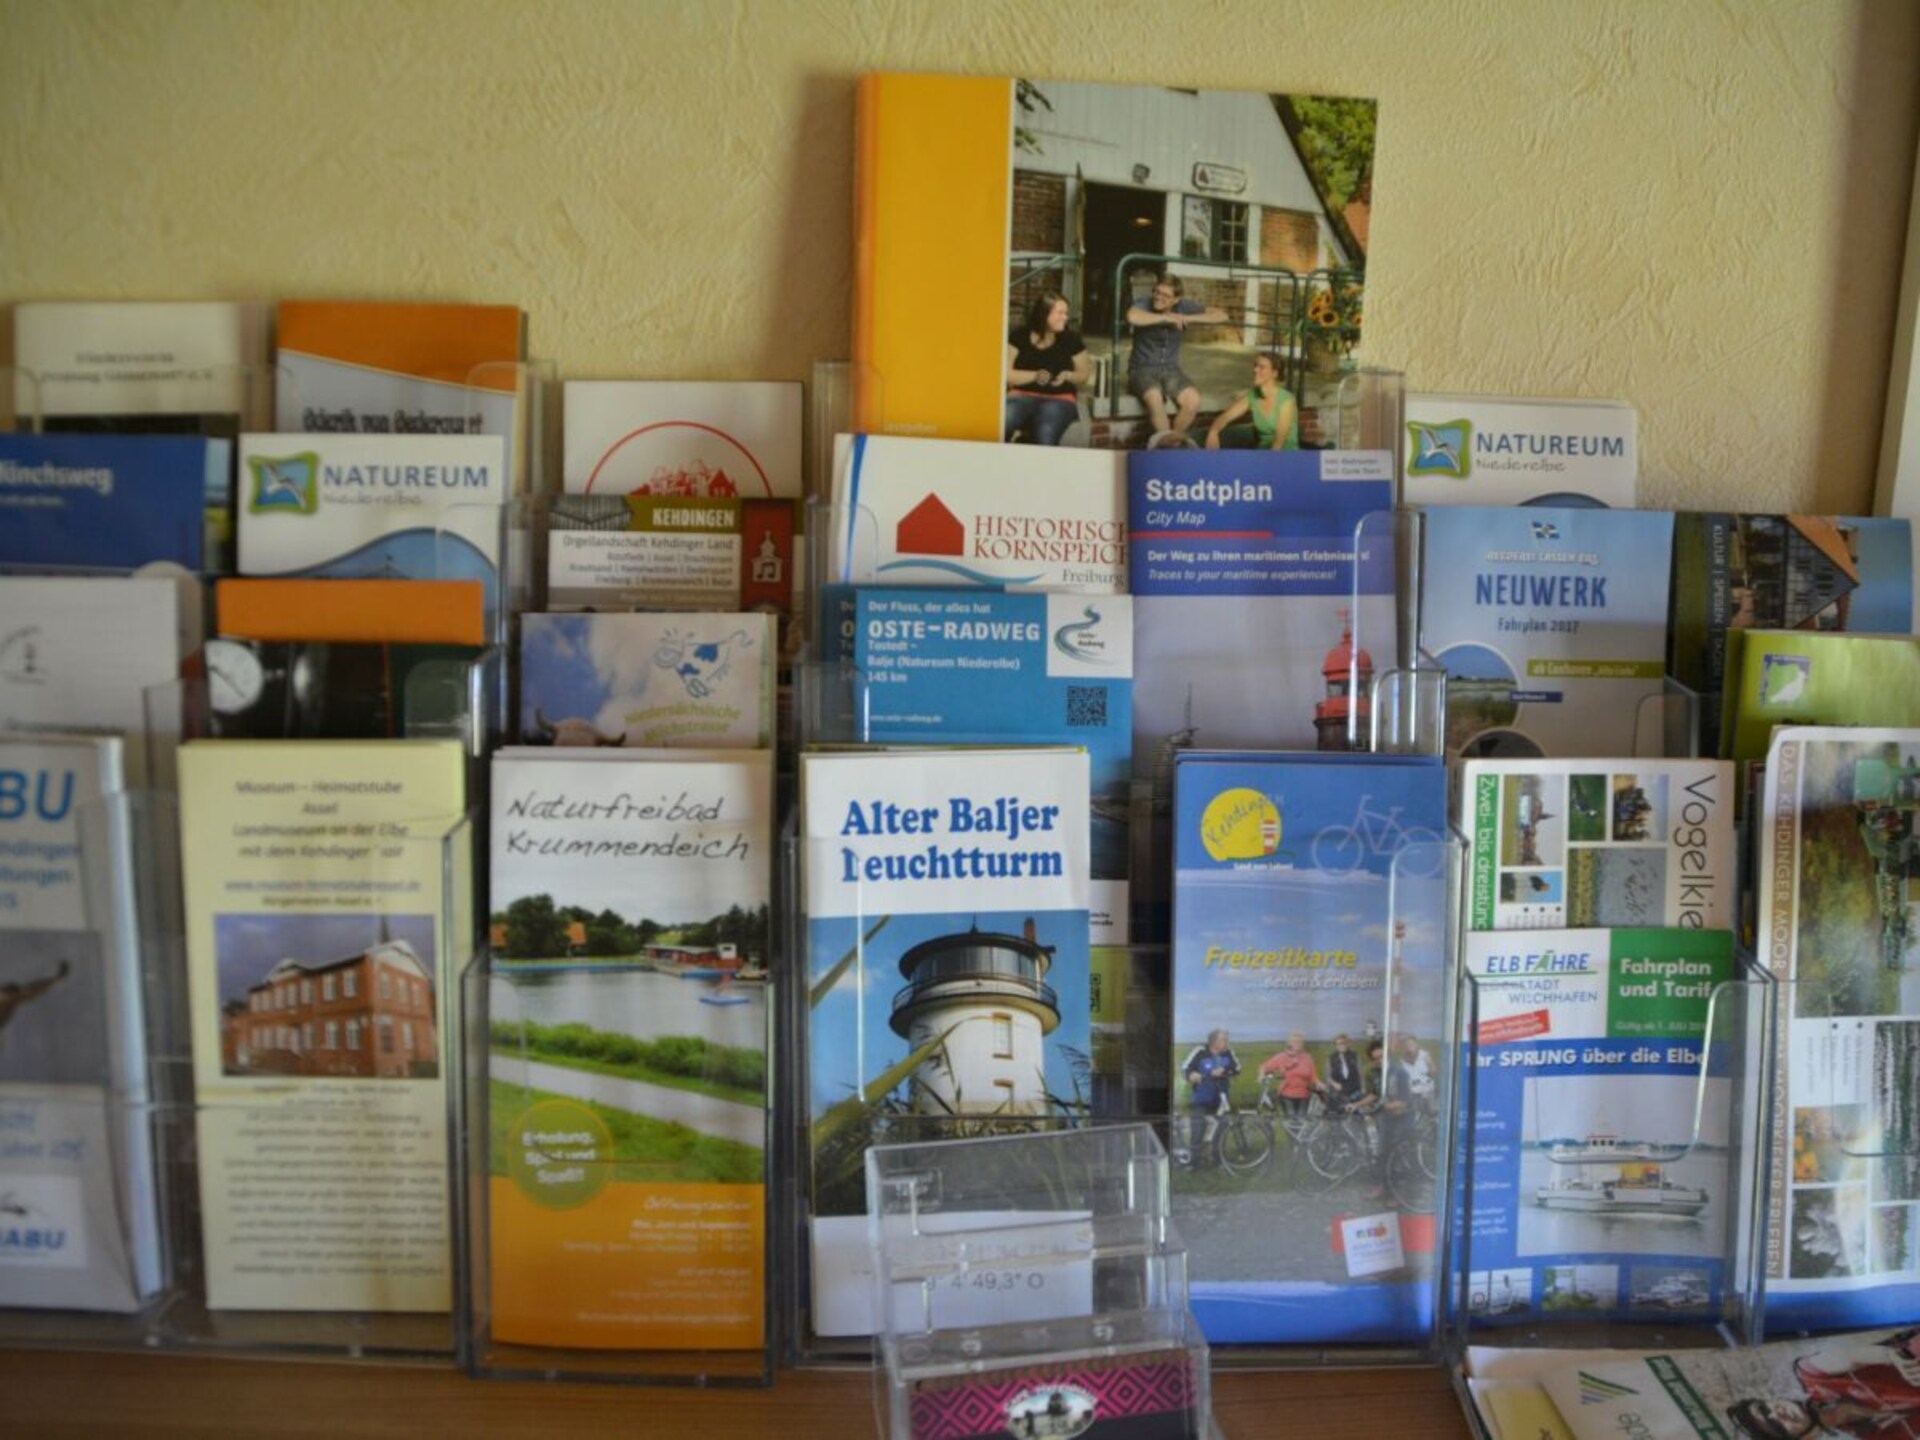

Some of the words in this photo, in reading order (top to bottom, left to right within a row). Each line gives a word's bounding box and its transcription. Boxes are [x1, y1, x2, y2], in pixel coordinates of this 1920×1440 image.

[1476, 432, 1623, 457] NATUREUM
[1476, 456, 1566, 472] Niederelbe
[0, 458, 114, 496] önchsweg
[323, 464, 488, 487] NATUREUM
[1146, 478, 1273, 506] Stadtplan
[652, 508, 735, 527] KEHDINGEN
[1146, 511, 1174, 527] City
[1177, 511, 1206, 526] Map
[563, 535, 647, 549] Orgellandschaft
[651, 536, 704, 550] Kehdinger
[707, 538, 733, 549] Land
[1148, 550, 1167, 561] Der
[1170, 550, 1194, 564] Weg
[1197, 552, 1209, 561] zu
[1212, 550, 1241, 561] Ihren
[1244, 550, 1300, 561] maritimen
[1062, 568, 1127, 585] Freiburg
[1149, 569, 1182, 581] Traces
[1184, 569, 1196, 580] to
[1197, 571, 1221, 583] your
[1223, 569, 1268, 581] maritime
[1270, 569, 1337, 583] experiences!
[1475, 573, 1608, 607] NEUWERK
[868, 601, 888, 613] Der
[890, 601, 922, 614] Fluss,
[924, 602, 943, 614] der
[945, 602, 970, 614] alles
[972, 603, 991, 614] hat
[868, 620, 1040, 641] OSTE-RADWEG
[1497, 617, 1547, 634] Fahrplan
[1550, 619, 1580, 634] 2017
[867, 656, 895, 669] Balje
[897, 656, 955, 669] (Natureum
[957, 657, 1020, 670] Niederelbe)
[868, 671, 888, 683] 145
[890, 671, 908, 682] km
[1779, 744, 1796, 785] DAS
[234, 780, 295, 794] Museum
[506, 790, 724, 822] Naturfreibad
[1479, 775, 1496, 825] Zwei-
[840, 799, 940, 836] Alter
[948, 796, 1060, 841] Baljer
[506, 830, 750, 860] Krummendeich
[1478, 827, 1495, 853] bis
[1775, 791, 1794, 902] KEHDINGER
[1772, 908, 1790, 971] MOOR
[1204, 945, 1358, 969] Freizeitkarte
[1486, 955, 1520, 974] ELB
[1619, 957, 1712, 979] Fahrplan
[1619, 981, 1658, 998] und
[1663, 980, 1713, 998] Tarif
[1501, 1048, 1577, 1067] SPRUNG
[1582, 1047, 1626, 1064] über
[1630, 1047, 1662, 1064] die
[0, 1229, 66, 1250] ABU
[1027, 1272, 1045, 1290] O
